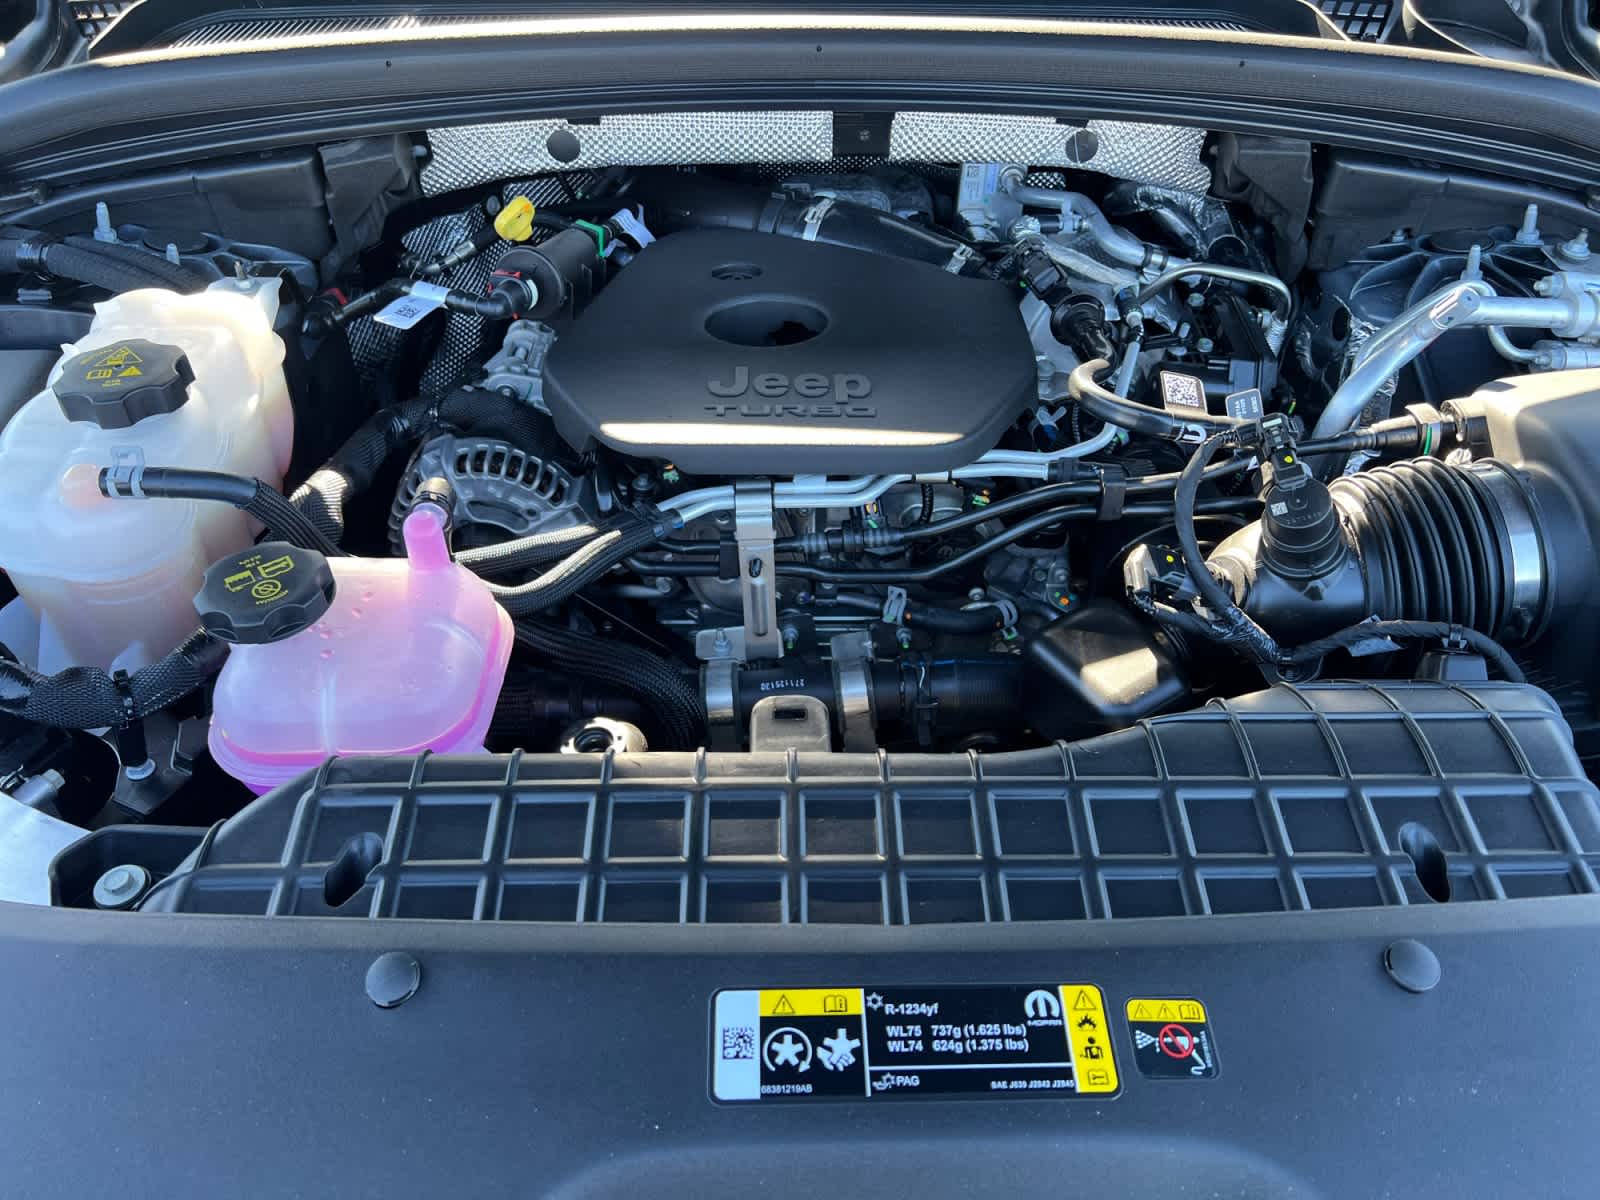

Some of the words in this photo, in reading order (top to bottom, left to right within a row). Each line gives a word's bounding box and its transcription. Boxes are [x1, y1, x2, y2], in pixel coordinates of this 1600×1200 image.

[707, 366, 872, 404] Jeep
[704, 404, 877, 417] TURBO
[884, 1002, 939, 1016] R-1234yf
[886, 1025, 922, 1037] WL75
[931, 1025, 962, 1039] 737g
[964, 1024, 1000, 1038] (1.625
[1003, 1023, 1027, 1037] lbs)
[887, 1040, 923, 1052] WL74
[932, 1040, 963, 1053] 624g
[965, 1039, 1003, 1053] (1.375
[1005, 1038, 1029, 1052] lbs)
[896, 1075, 920, 1087] PAG
